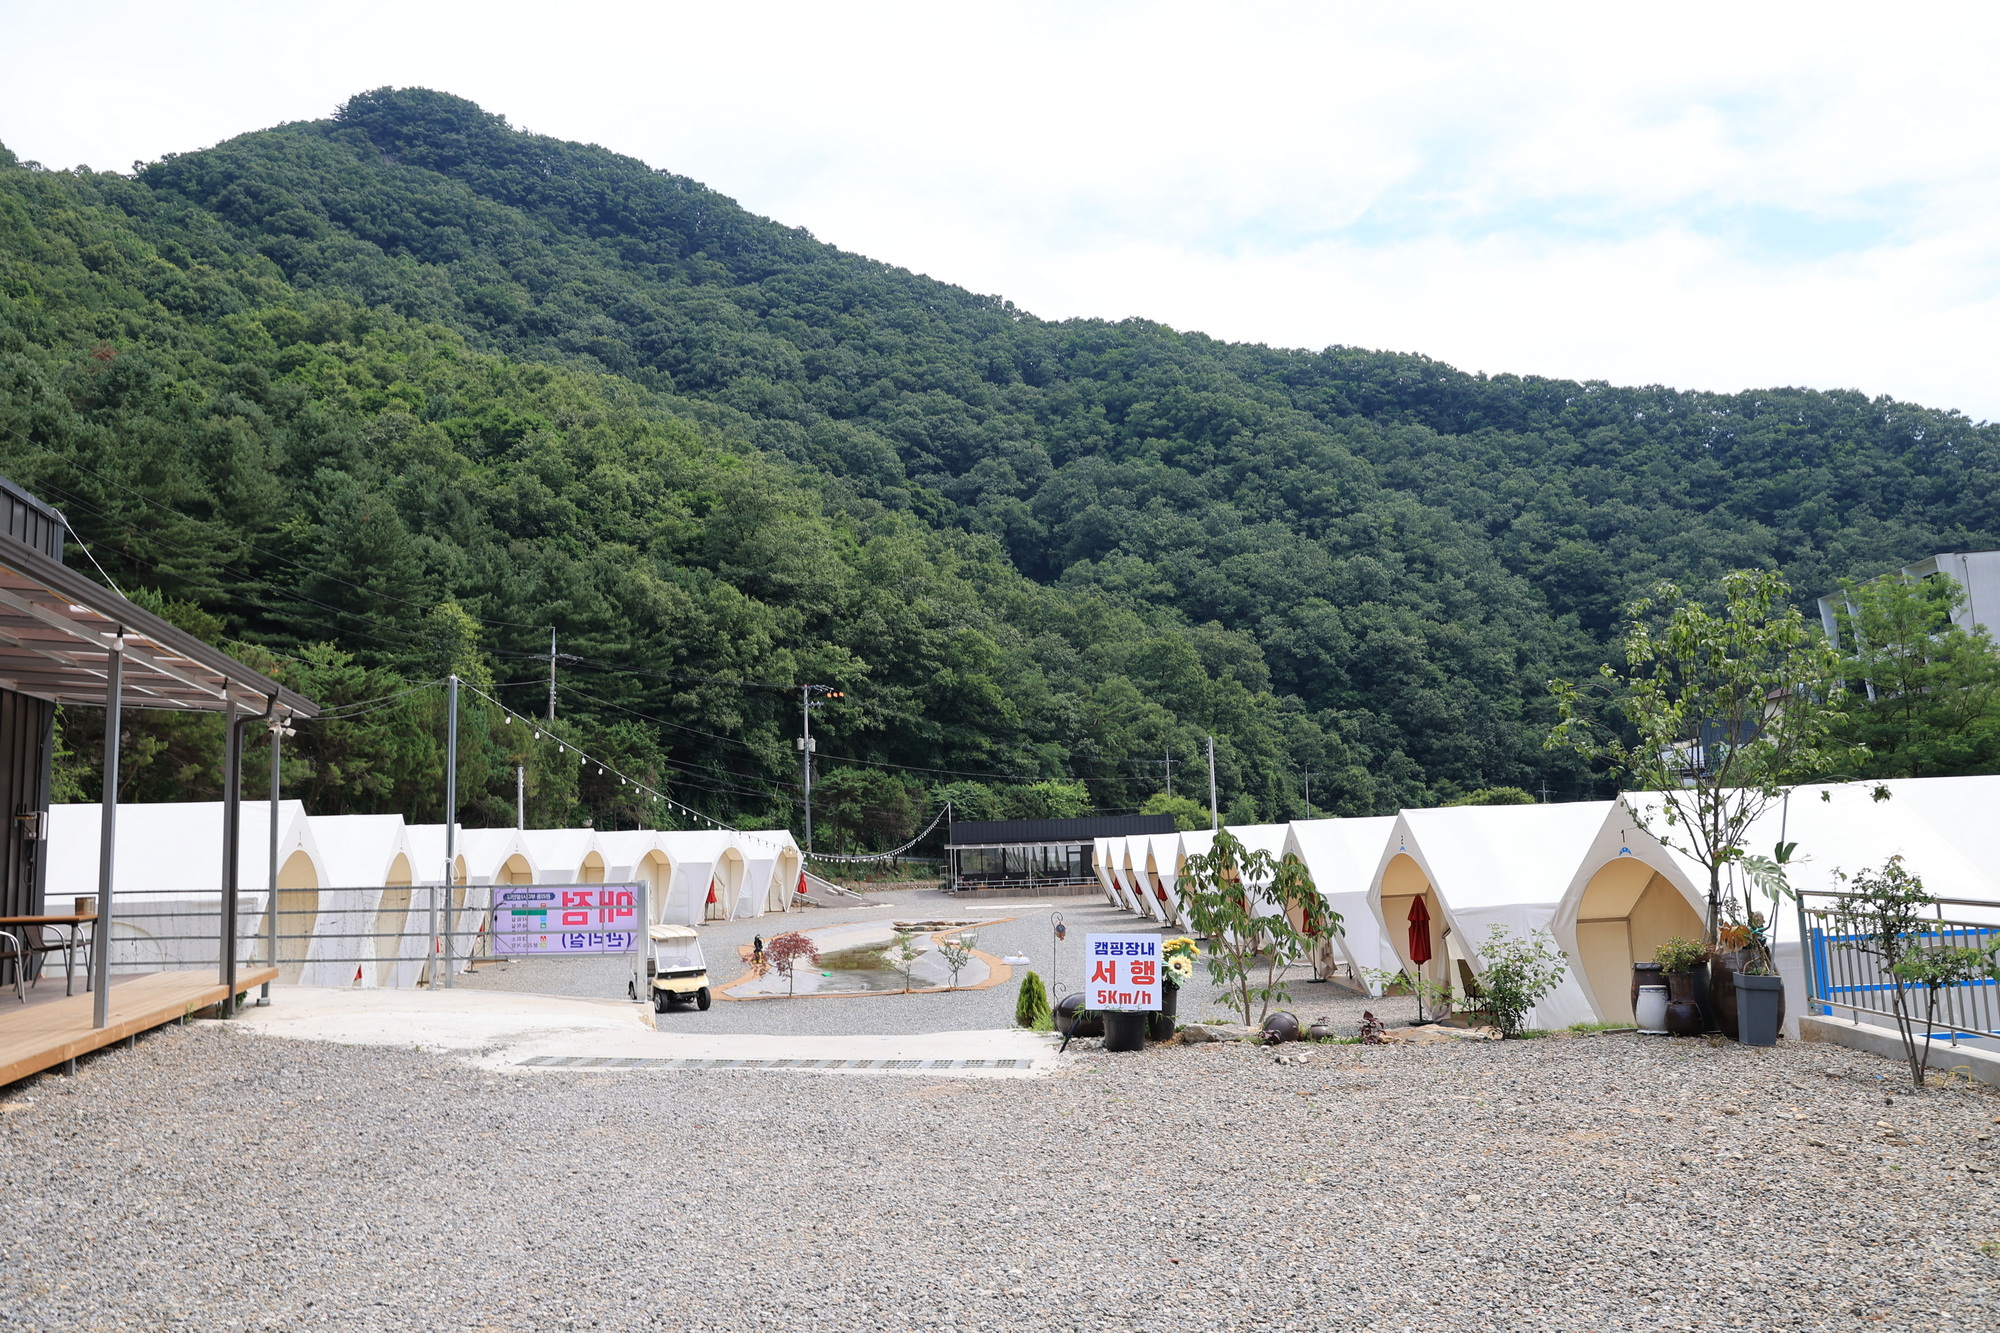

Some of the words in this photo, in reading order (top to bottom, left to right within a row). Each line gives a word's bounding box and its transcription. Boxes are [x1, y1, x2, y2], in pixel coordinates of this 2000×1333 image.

[1620, 829, 1626, 843] 1
[1094, 941, 1155, 956] 캠핑장내
[1097, 990, 1152, 1005] 5Km/h
